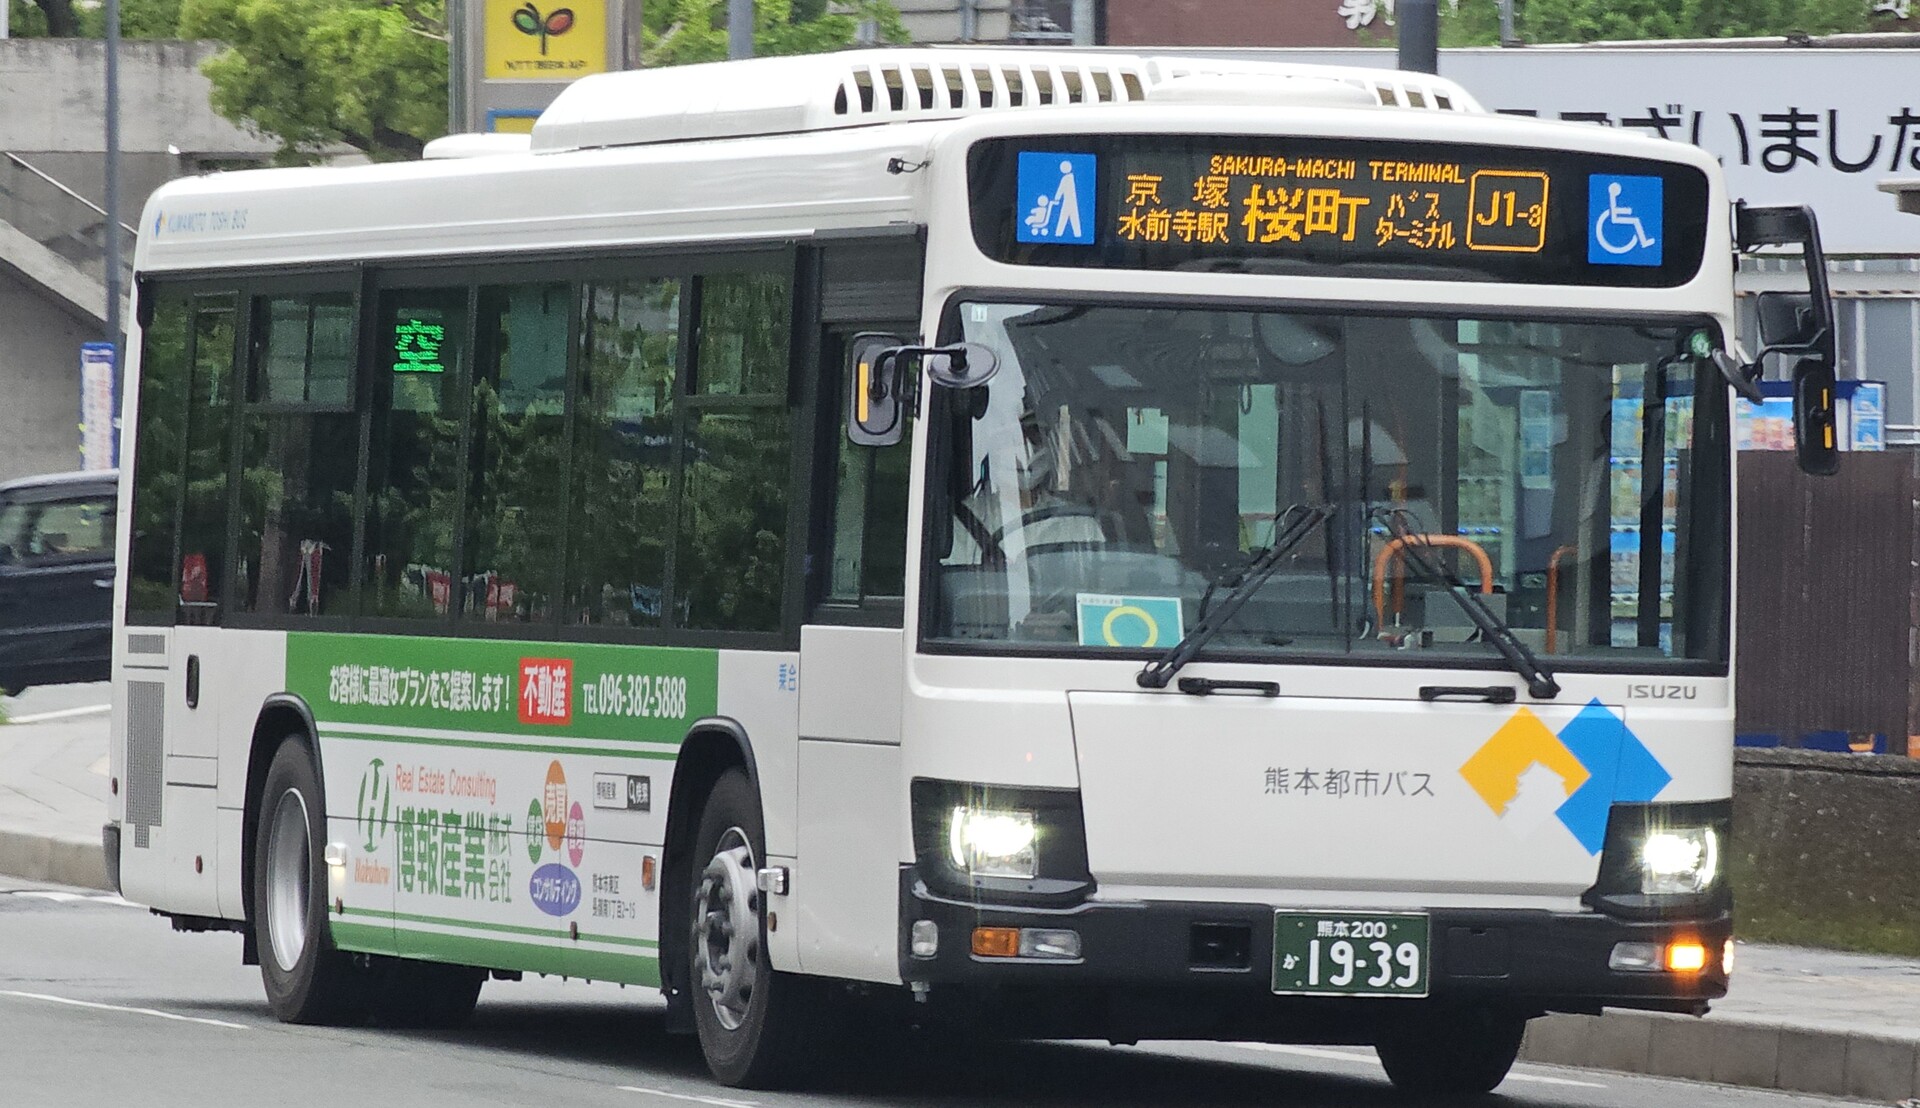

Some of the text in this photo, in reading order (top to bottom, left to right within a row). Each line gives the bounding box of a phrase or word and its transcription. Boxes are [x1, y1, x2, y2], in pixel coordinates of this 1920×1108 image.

[1210, 154, 1466, 185] SAKURA-MACHI TERMINAL
[1117, 206, 1230, 244] 水前寺駅
[1241, 183, 1370, 243] 桜町
[1475, 190, 1543, 228] J1-3
[1375, 216, 1456, 249] ターミナル
[523, 665, 567, 718] 不動産
[599, 673, 687, 720] 096-382-5888
[1627, 683, 1698, 701] ISUZU
[395, 764, 497, 806] Real Estate Consulting
[1263, 766, 1436, 799] 熊本都市バス
[1282, 939, 1420, 987] か 19-39
